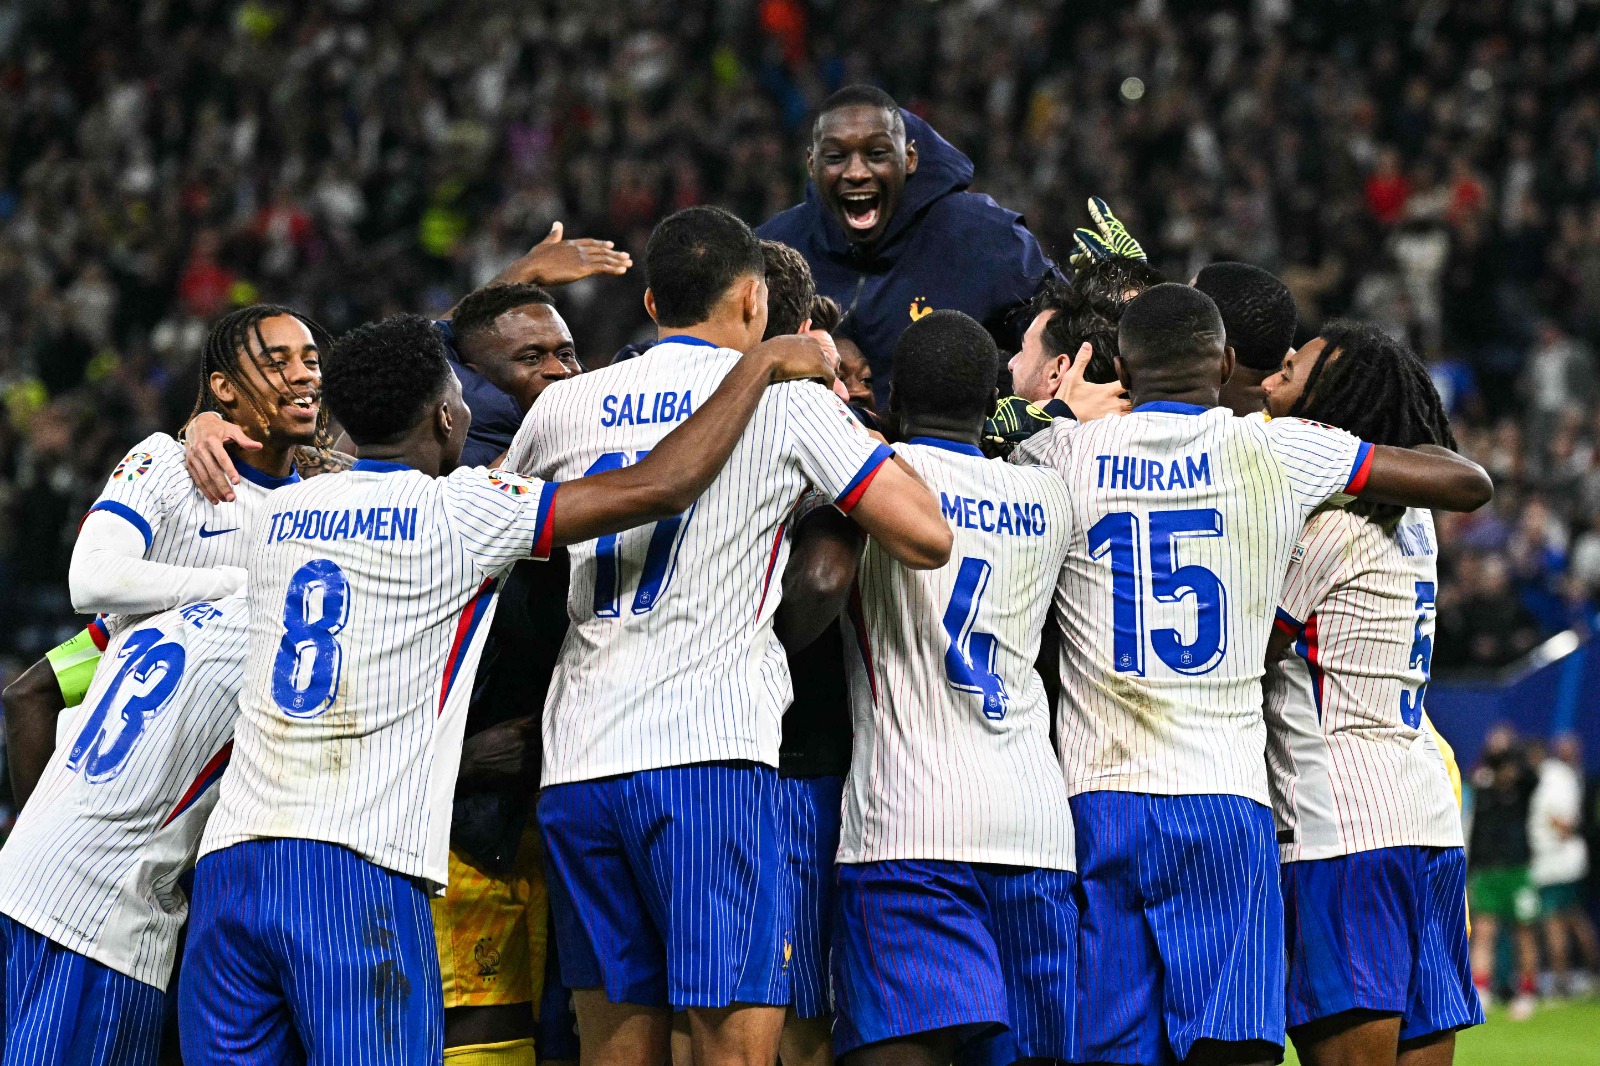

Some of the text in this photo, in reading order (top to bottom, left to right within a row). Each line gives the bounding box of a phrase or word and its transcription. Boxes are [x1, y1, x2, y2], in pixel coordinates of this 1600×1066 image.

[601, 389, 693, 428] SALIBA
[1096, 452, 1212, 492] THURAM
[267, 507, 418, 545] TCHOUAMENI
[940, 491, 1046, 537] MECANO
[271, 558, 351, 720] 8
[943, 556, 1011, 721] 4
[1087, 507, 1228, 678] 15
[1400, 581, 1436, 731] 5
[66, 627, 187, 785] 13
